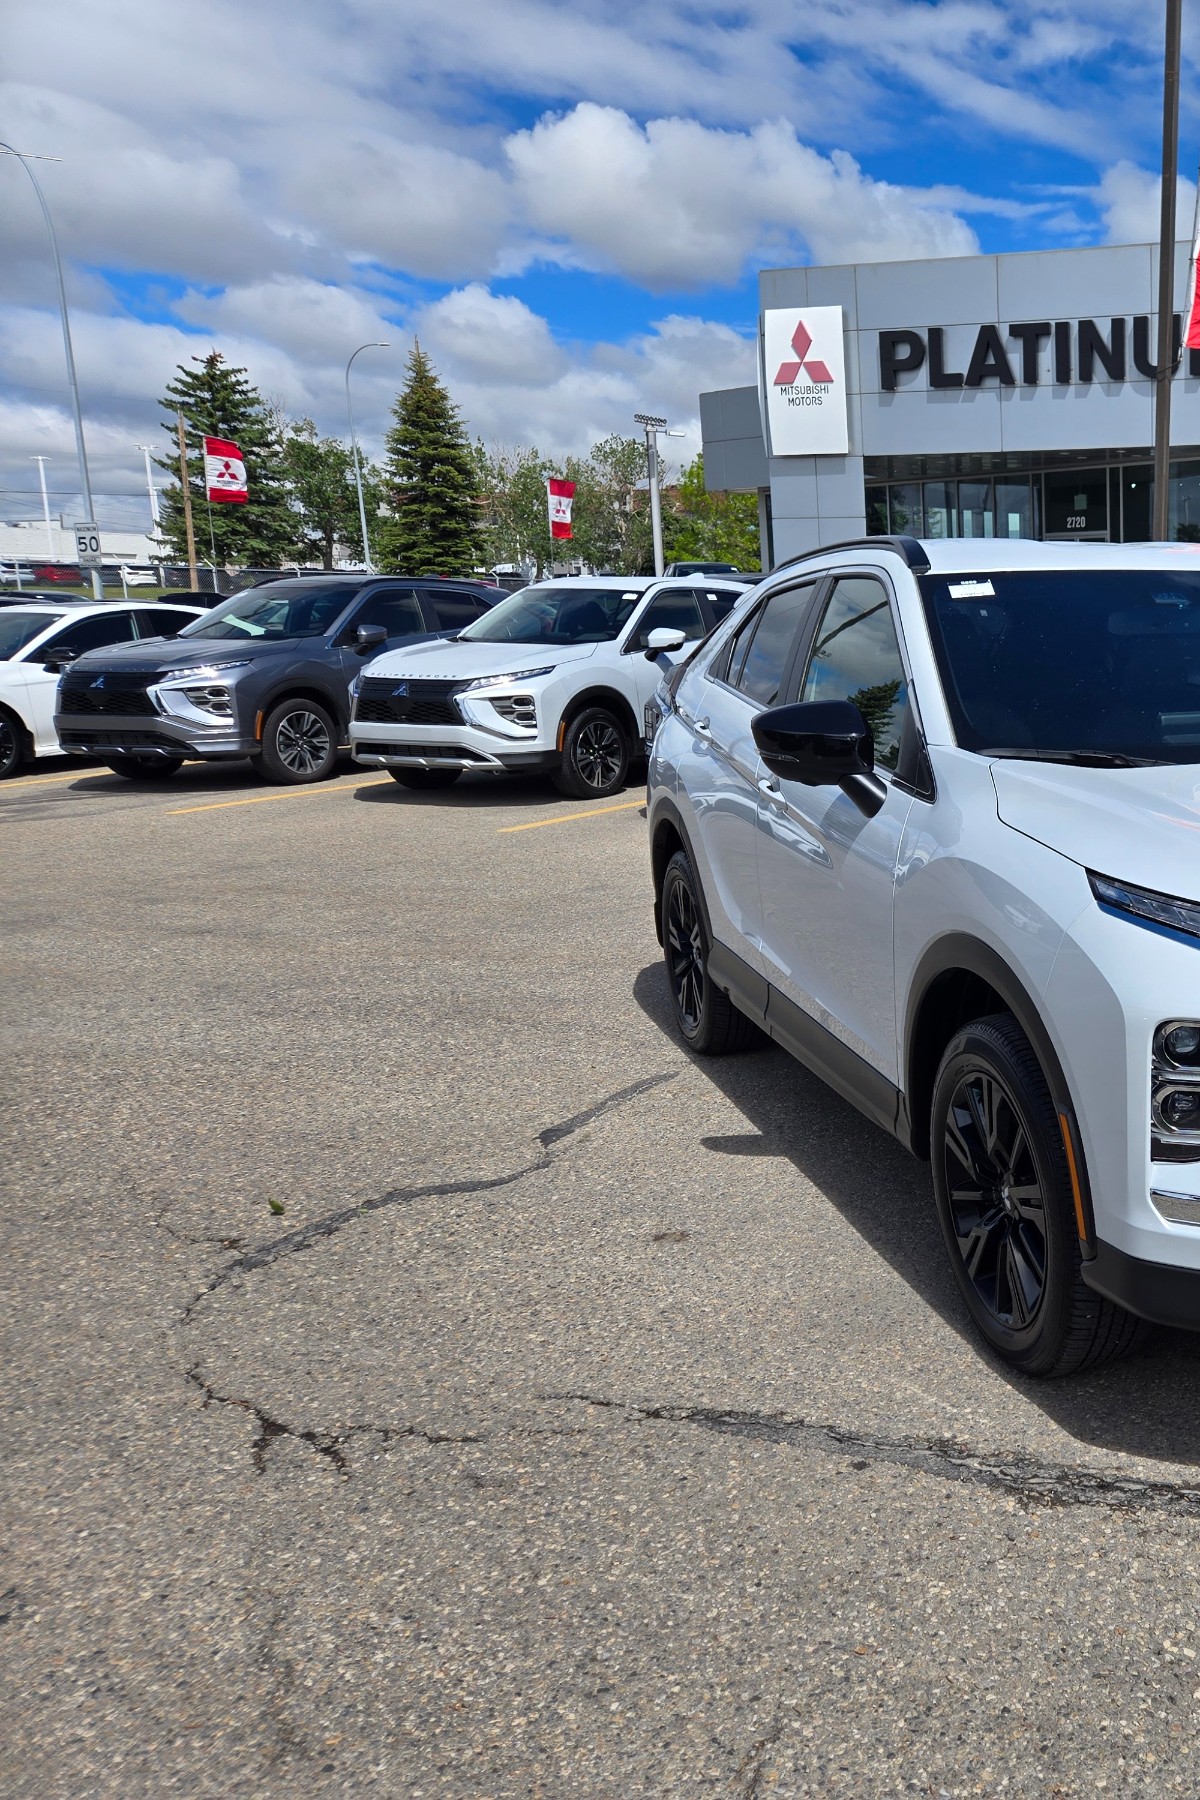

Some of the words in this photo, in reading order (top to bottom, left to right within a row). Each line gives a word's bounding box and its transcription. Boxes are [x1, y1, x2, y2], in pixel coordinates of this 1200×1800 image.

[780, 384, 829, 396] MITSUBISHI
[787, 396, 823, 407] MOTORS
[1066, 516, 1086, 529] 2720
[78, 535, 99, 552] 50
